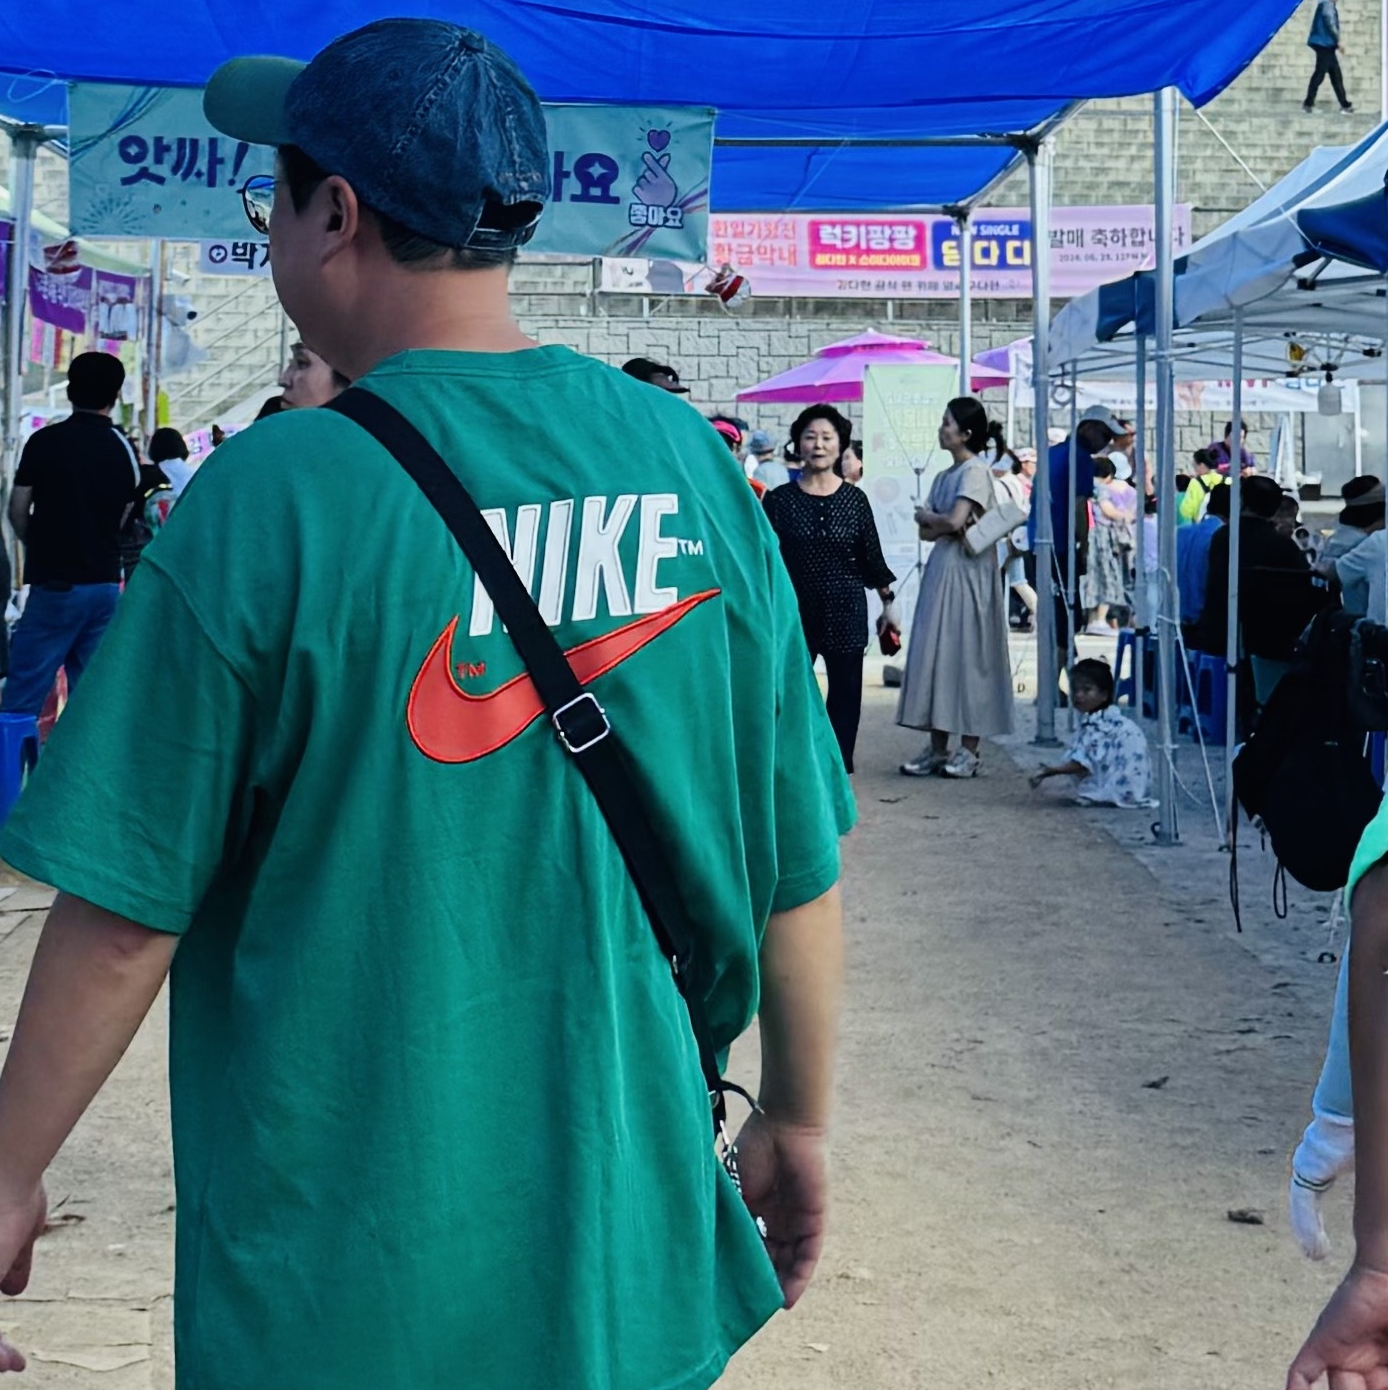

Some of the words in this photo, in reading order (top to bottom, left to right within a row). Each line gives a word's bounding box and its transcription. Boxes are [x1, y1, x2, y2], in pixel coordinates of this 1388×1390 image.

[118, 135, 249, 188] 앗싸!
[629, 203, 684, 228] 좋아요
[818, 223, 918, 250] 럭키팡팡
[951, 224, 978, 236] NW
[979, 224, 1020, 236] SINGLE
[469, 493, 678, 636] NIKE
